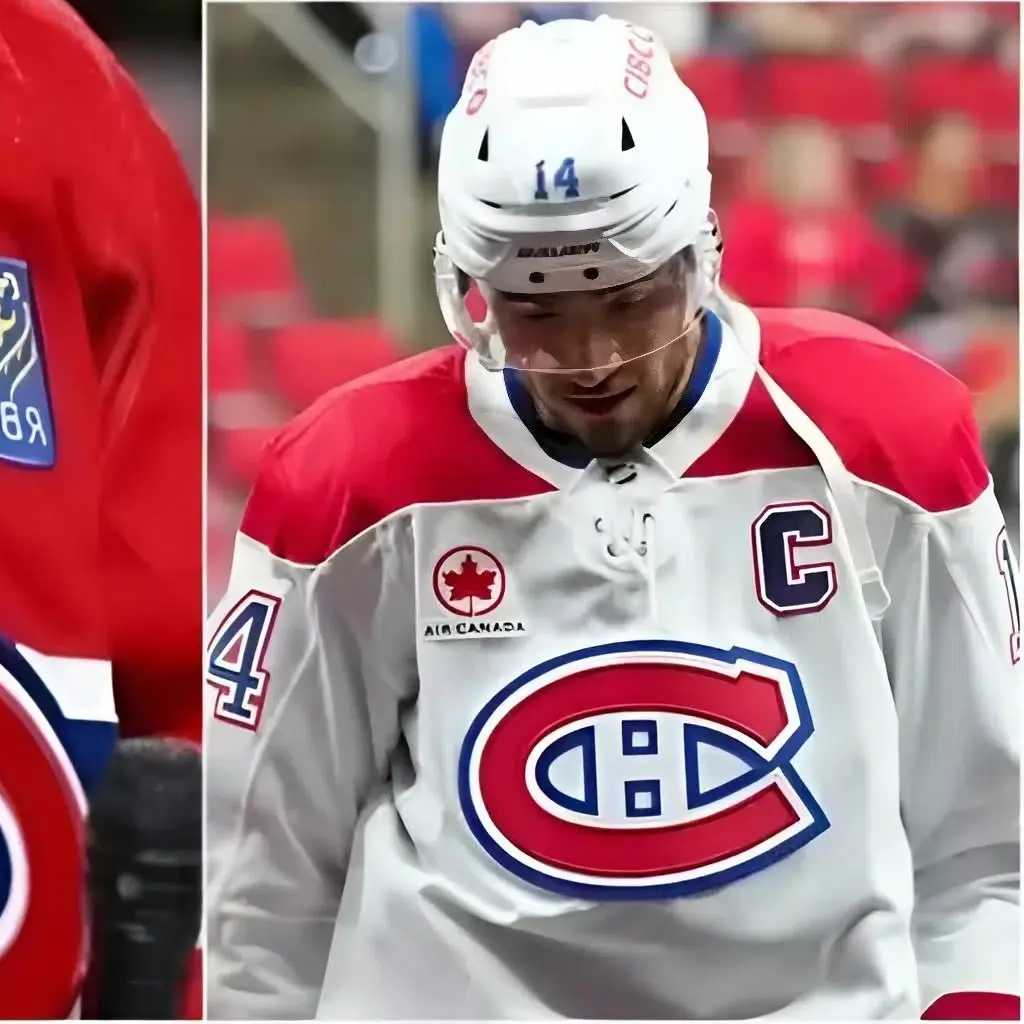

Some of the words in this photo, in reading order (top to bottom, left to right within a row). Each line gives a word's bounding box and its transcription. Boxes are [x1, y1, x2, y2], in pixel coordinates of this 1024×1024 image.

[534, 157, 580, 201] 14
[751, 501, 838, 617] C
[207, 589, 282, 733] 4
[455, 621, 525, 635] CANADA
